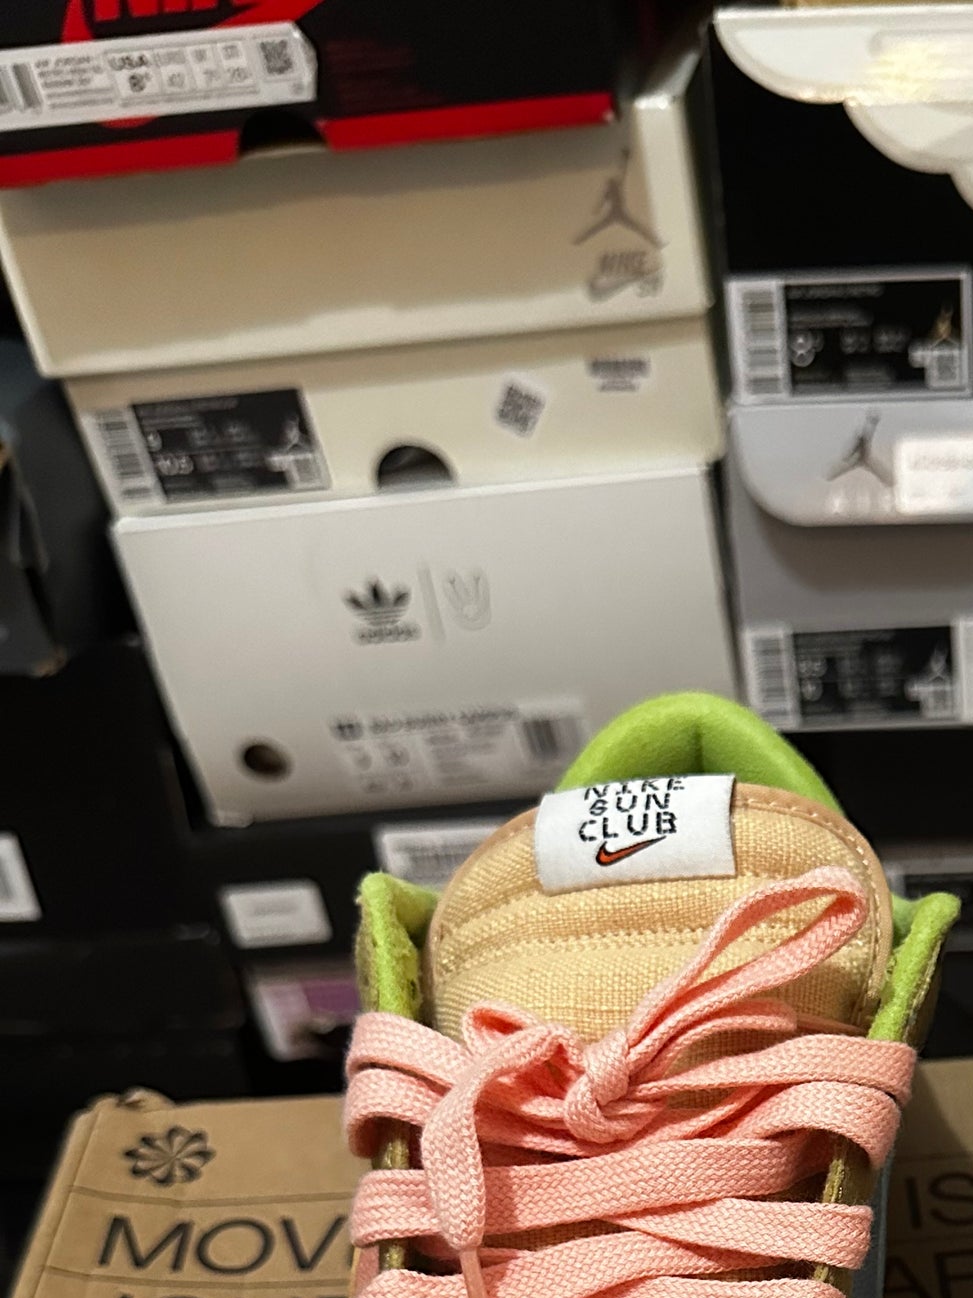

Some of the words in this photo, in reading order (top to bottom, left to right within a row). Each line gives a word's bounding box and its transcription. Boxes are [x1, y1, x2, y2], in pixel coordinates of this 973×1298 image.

[584, 778, 685, 800] NIKE
[589, 793, 671, 816] SUN
[579, 811, 677, 842] CLUB
[99, 1215, 352, 1274] MOV
